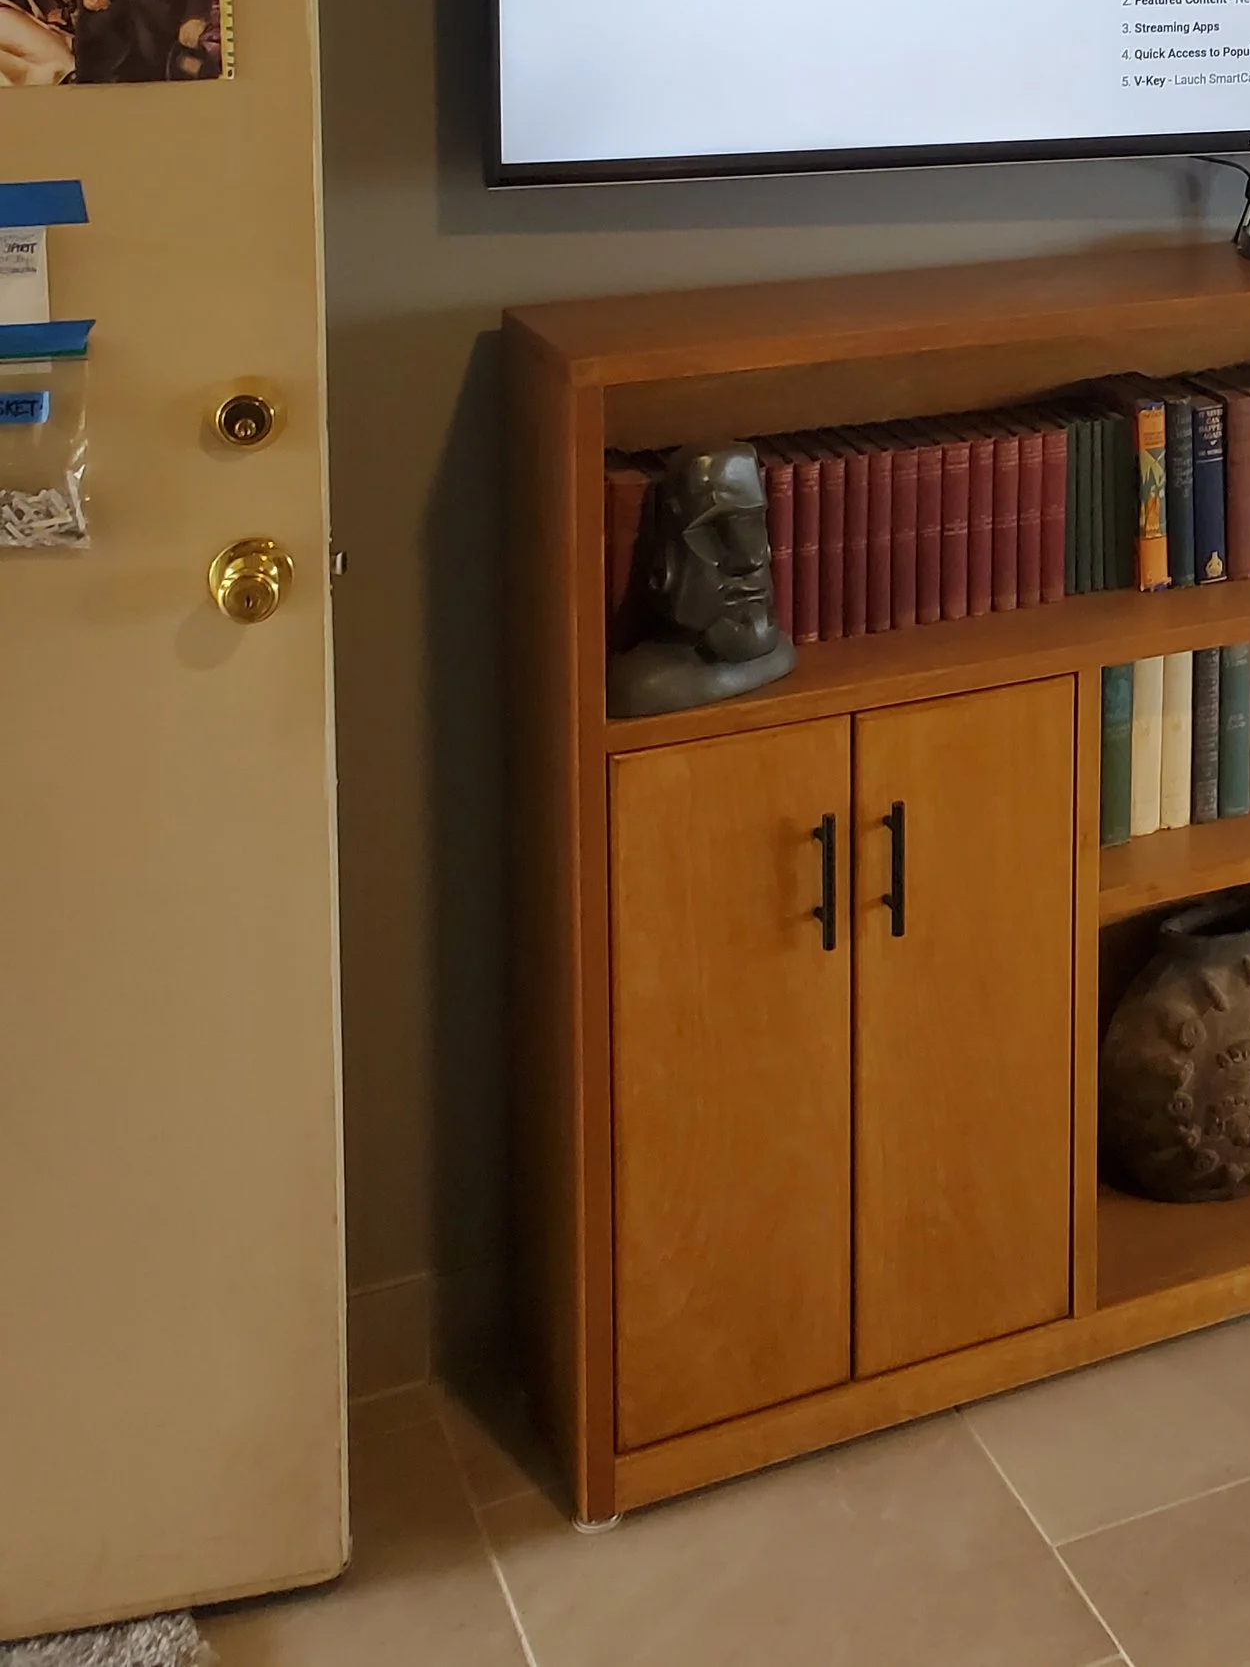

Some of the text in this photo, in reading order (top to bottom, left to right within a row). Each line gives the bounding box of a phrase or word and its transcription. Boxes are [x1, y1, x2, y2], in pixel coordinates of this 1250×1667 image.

[1121, 20, 1220, 35] 3. Streaming Apps
[1121, 48, 1131, 60] 4.
[1134, 47, 1166, 61] Quick
[1167, 47, 1207, 59] Access
[1208, 47, 1220, 57] to
[1121, 75, 1131, 87] 5.
[1133, 74, 1166, 88] V-Key
[1174, 72, 1207, 86] Lauch
